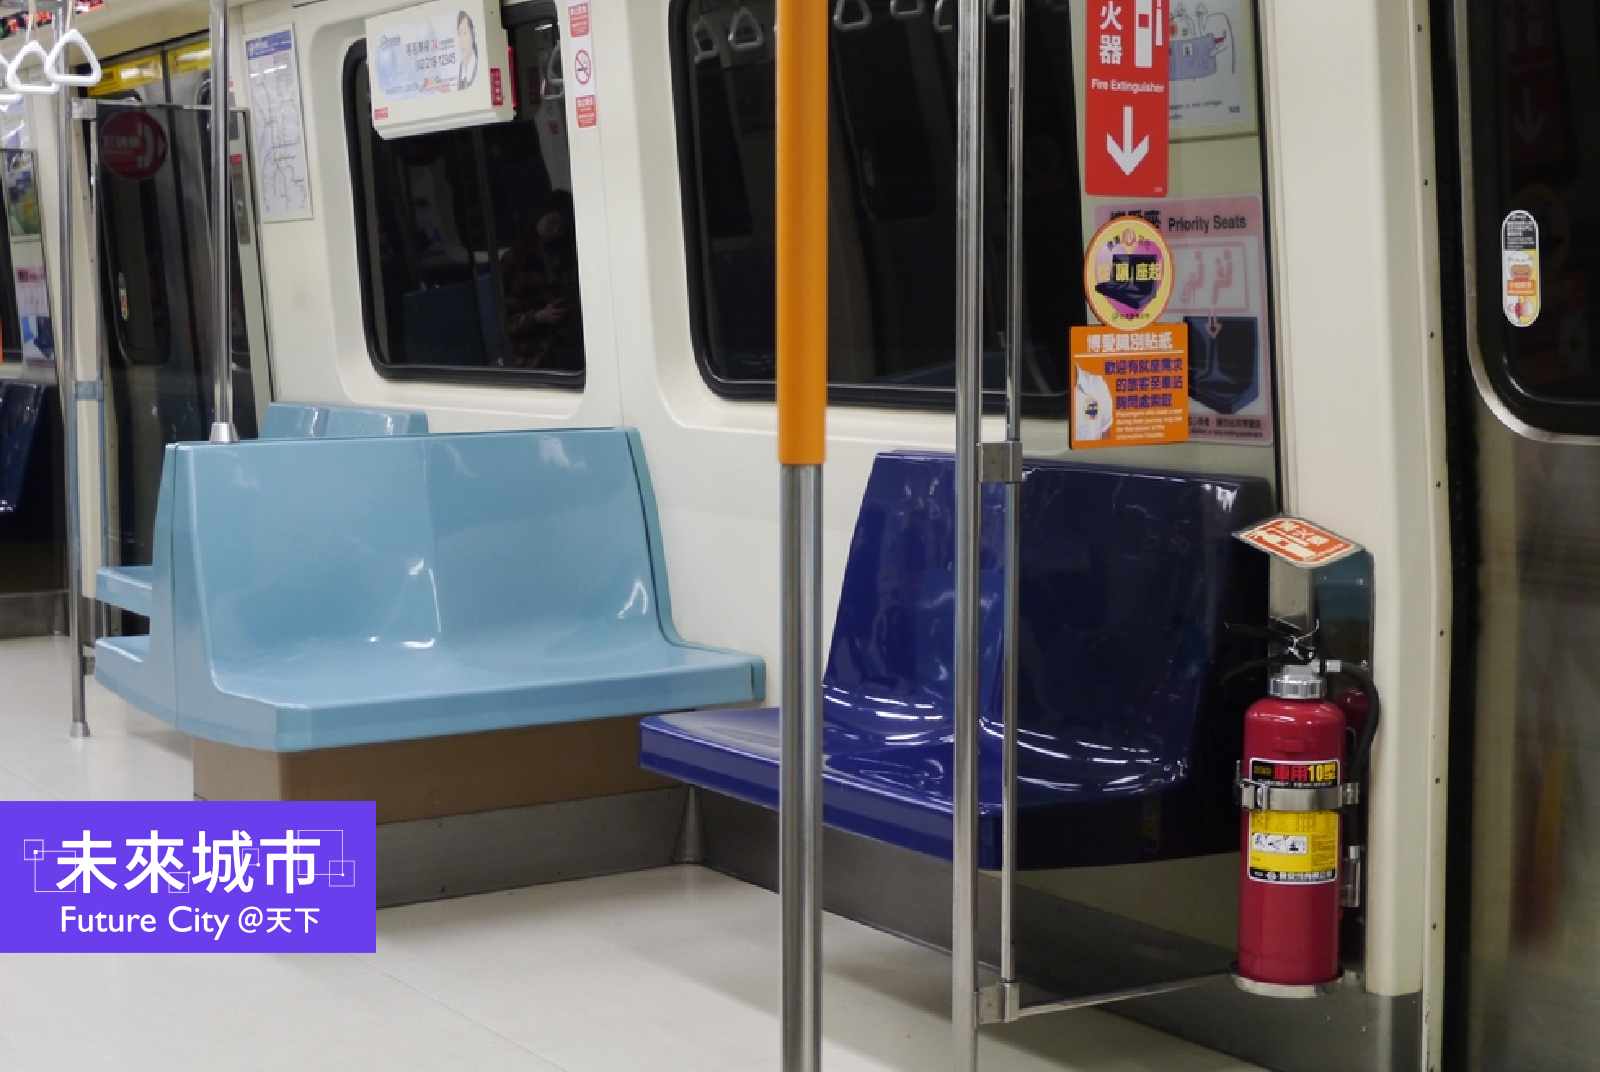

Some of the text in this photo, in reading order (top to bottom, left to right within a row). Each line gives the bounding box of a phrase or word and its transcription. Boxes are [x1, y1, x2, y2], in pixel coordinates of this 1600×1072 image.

[1100, 0, 1122, 65] 火器
[1091, 79, 1165, 94] Fire Extinguisher
[1167, 216, 1211, 234] Priority
[1213, 214, 1247, 230] Seats
